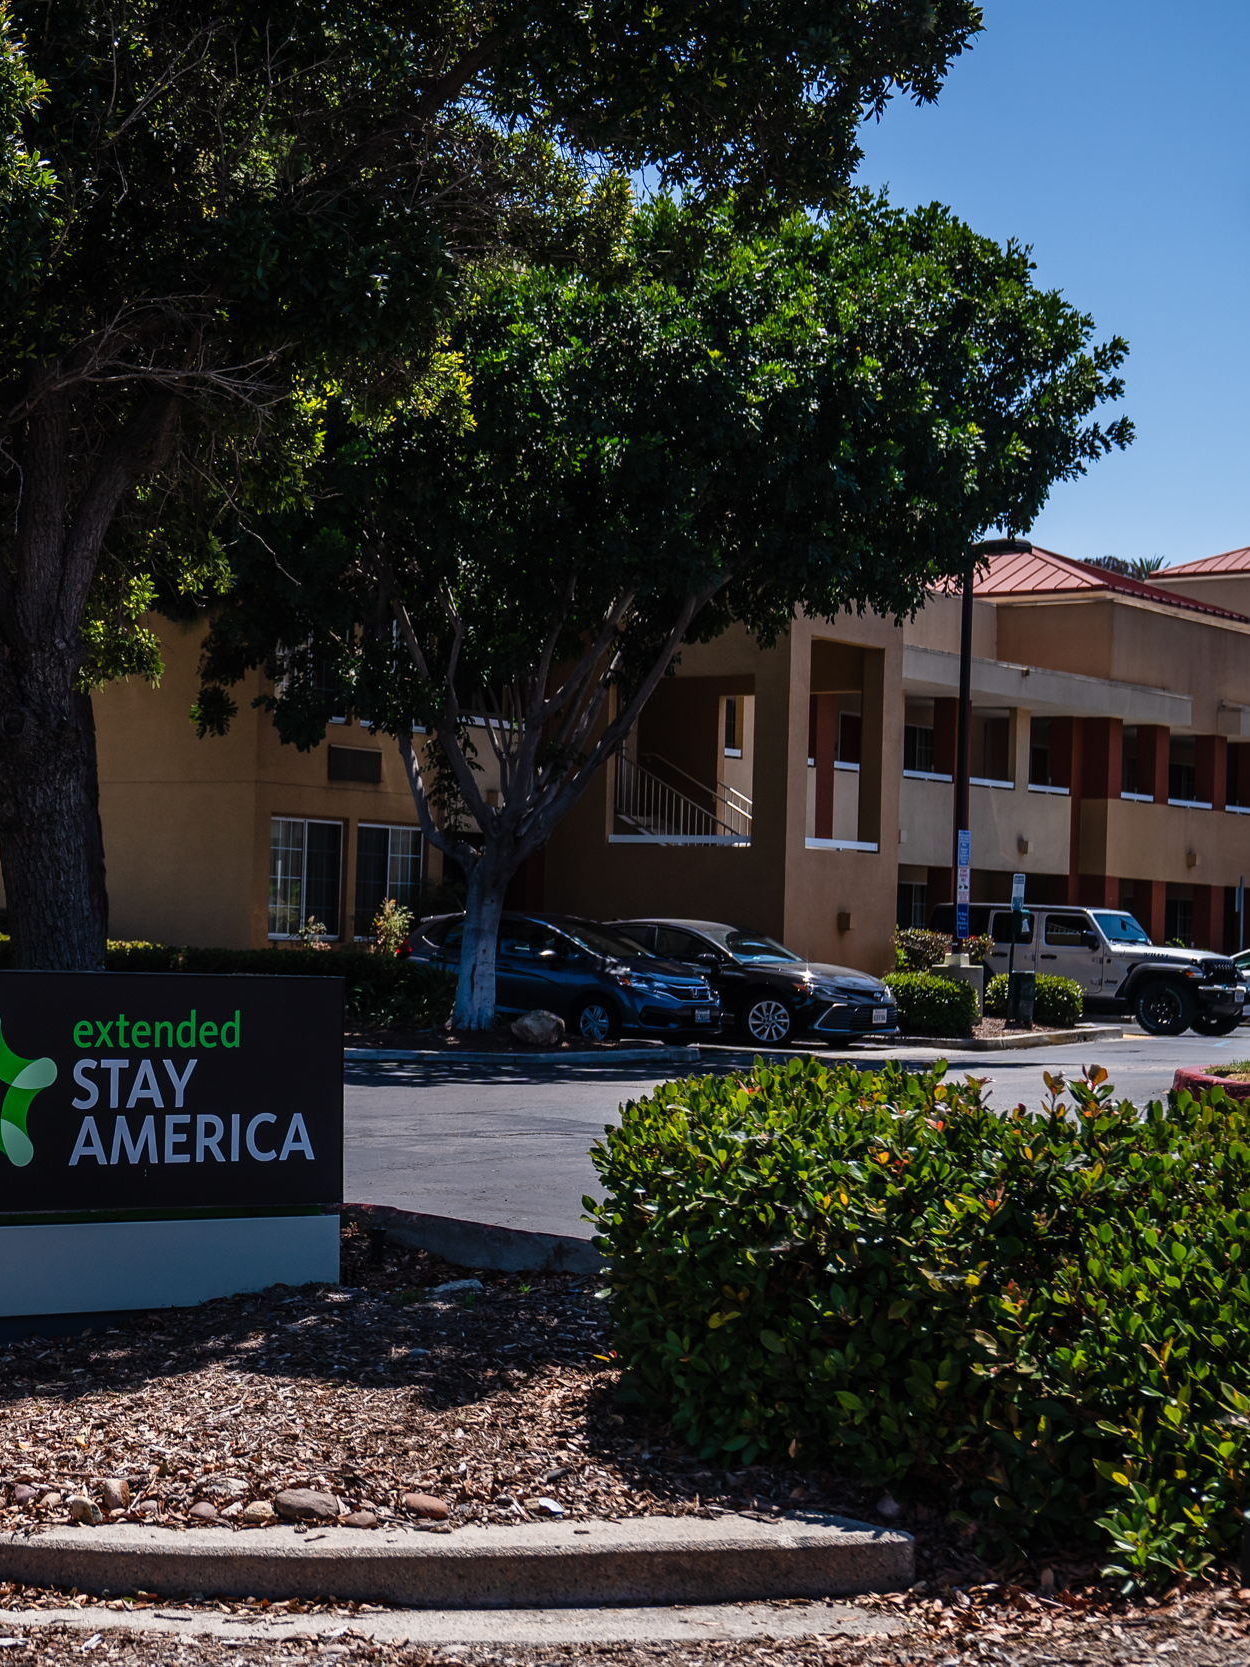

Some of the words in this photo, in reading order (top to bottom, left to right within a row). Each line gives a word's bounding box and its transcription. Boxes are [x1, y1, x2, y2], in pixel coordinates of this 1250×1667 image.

[73, 1009, 241, 1049] extended
[71, 1058, 198, 1110] STAY
[68, 1112, 316, 1166] AMERICA
